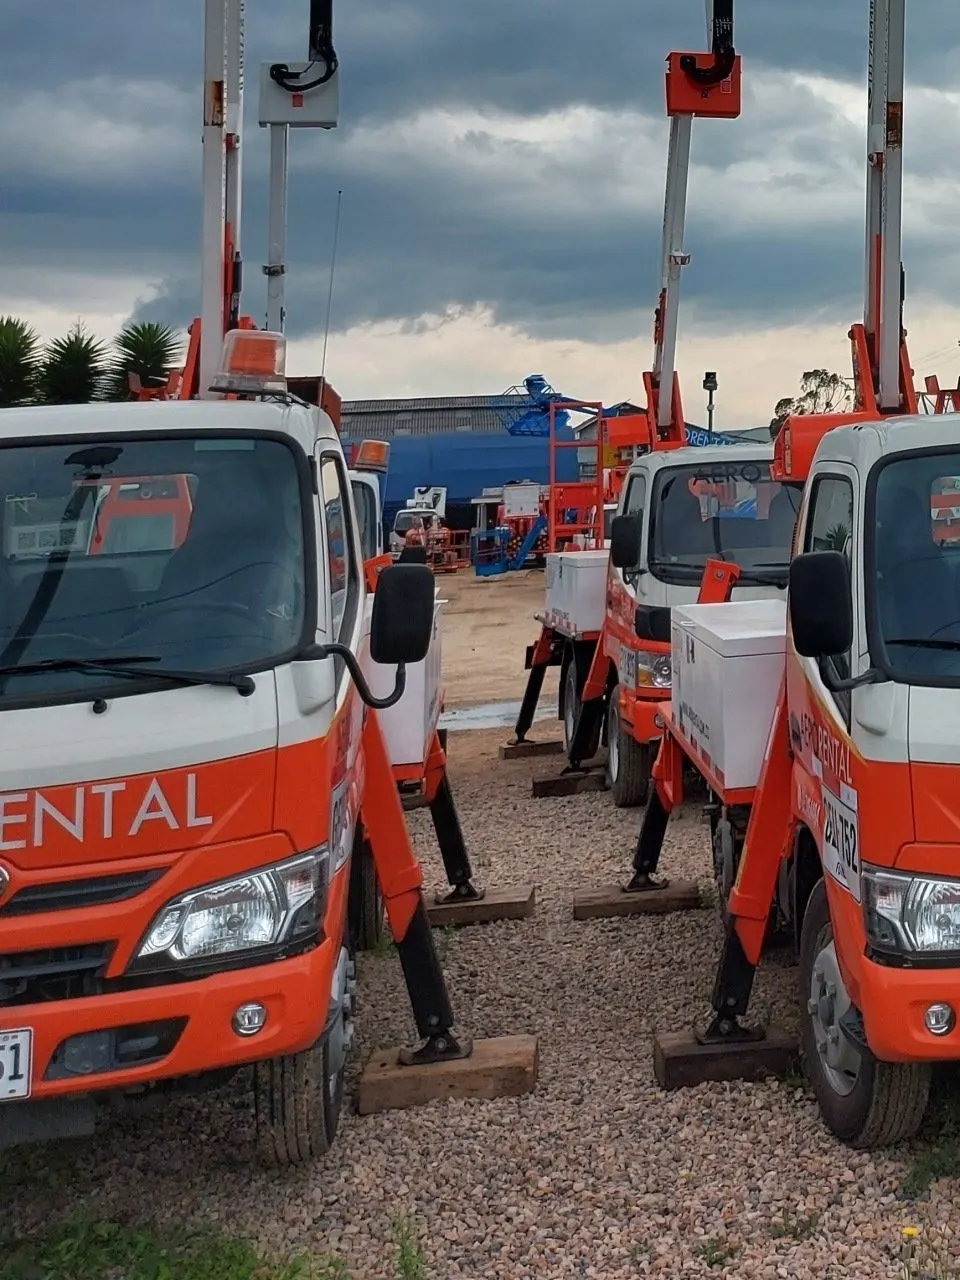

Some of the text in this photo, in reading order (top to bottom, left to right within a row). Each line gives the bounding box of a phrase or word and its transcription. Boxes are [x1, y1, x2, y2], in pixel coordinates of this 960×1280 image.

[692, 464, 761, 486] AERO
[800, 712, 853, 784] AERORENTAL
[0, 773, 213, 851] ENTAL
[838, 815, 858, 873] 752
